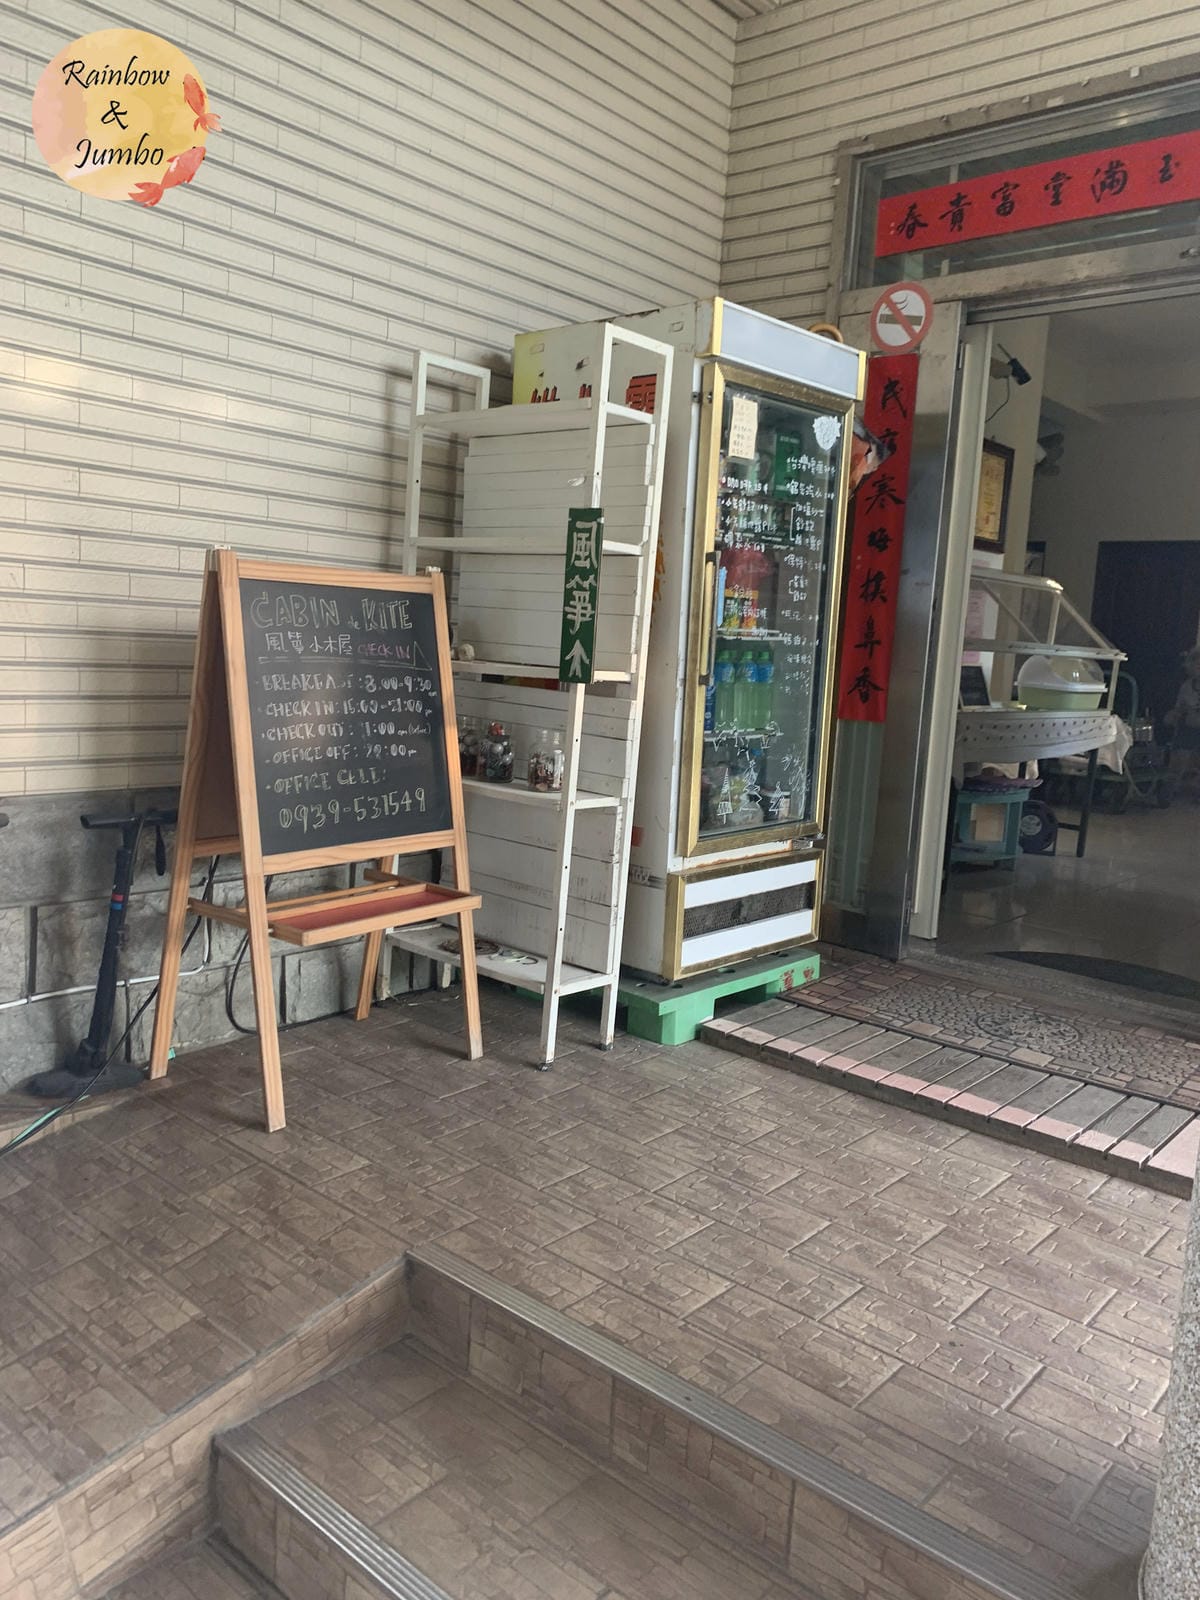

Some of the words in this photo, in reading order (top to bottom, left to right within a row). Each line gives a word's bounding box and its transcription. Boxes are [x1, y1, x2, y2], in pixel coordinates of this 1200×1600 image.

[564, 520, 598, 636] 風箏
[251, 592, 340, 629] CABIN
[361, 598, 413, 632] KITE
[265, 700, 312, 717] CHECK
[266, 723, 316, 741] CHECK
[272, 745, 323, 765] OFFICE
[273, 772, 332, 796] OFFICE
[278, 787, 427, 835] 0939-531549
